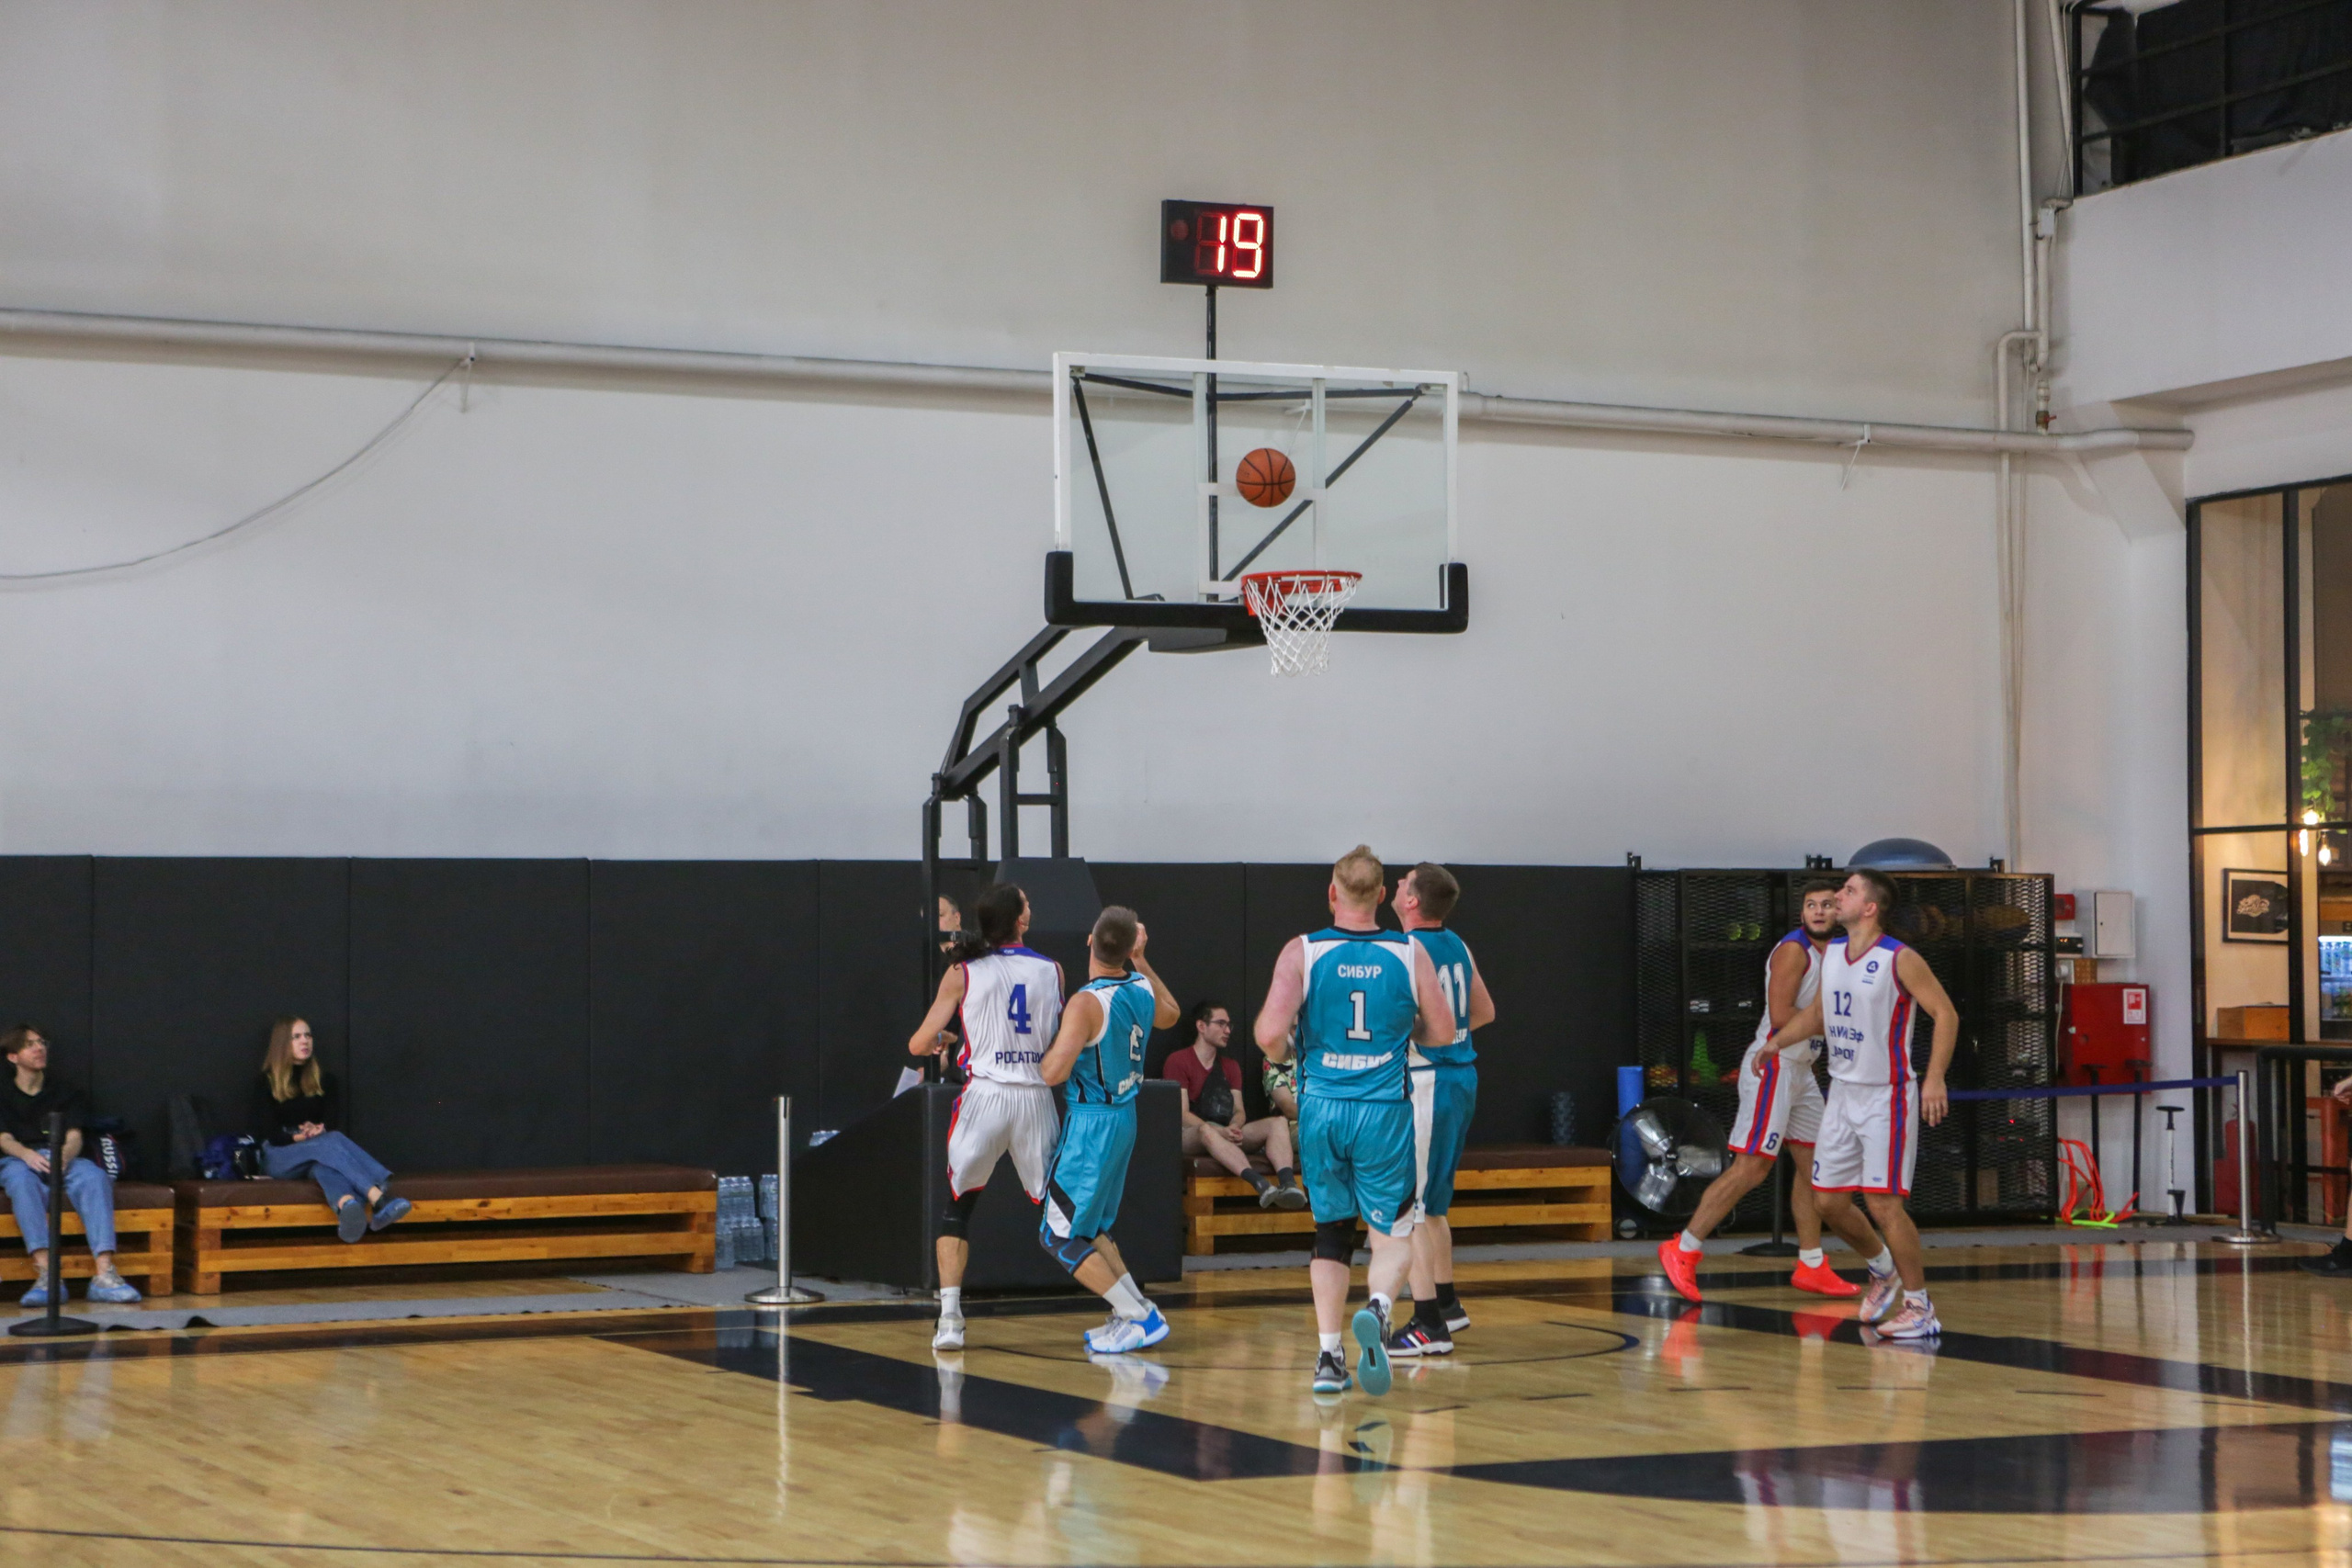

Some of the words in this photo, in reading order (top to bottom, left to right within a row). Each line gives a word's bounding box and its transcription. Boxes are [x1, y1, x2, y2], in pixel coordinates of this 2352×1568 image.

[1217, 212, 1264, 278] 19
[1338, 964, 1383, 979] СИБУР
[1008, 984, 1032, 1034] 4
[1347, 990, 1373, 1041] 1
[1833, 990, 1852, 1018] 12
[99, 1137, 119, 1179] RUSSI
[1766, 1133, 1780, 1150] 6
